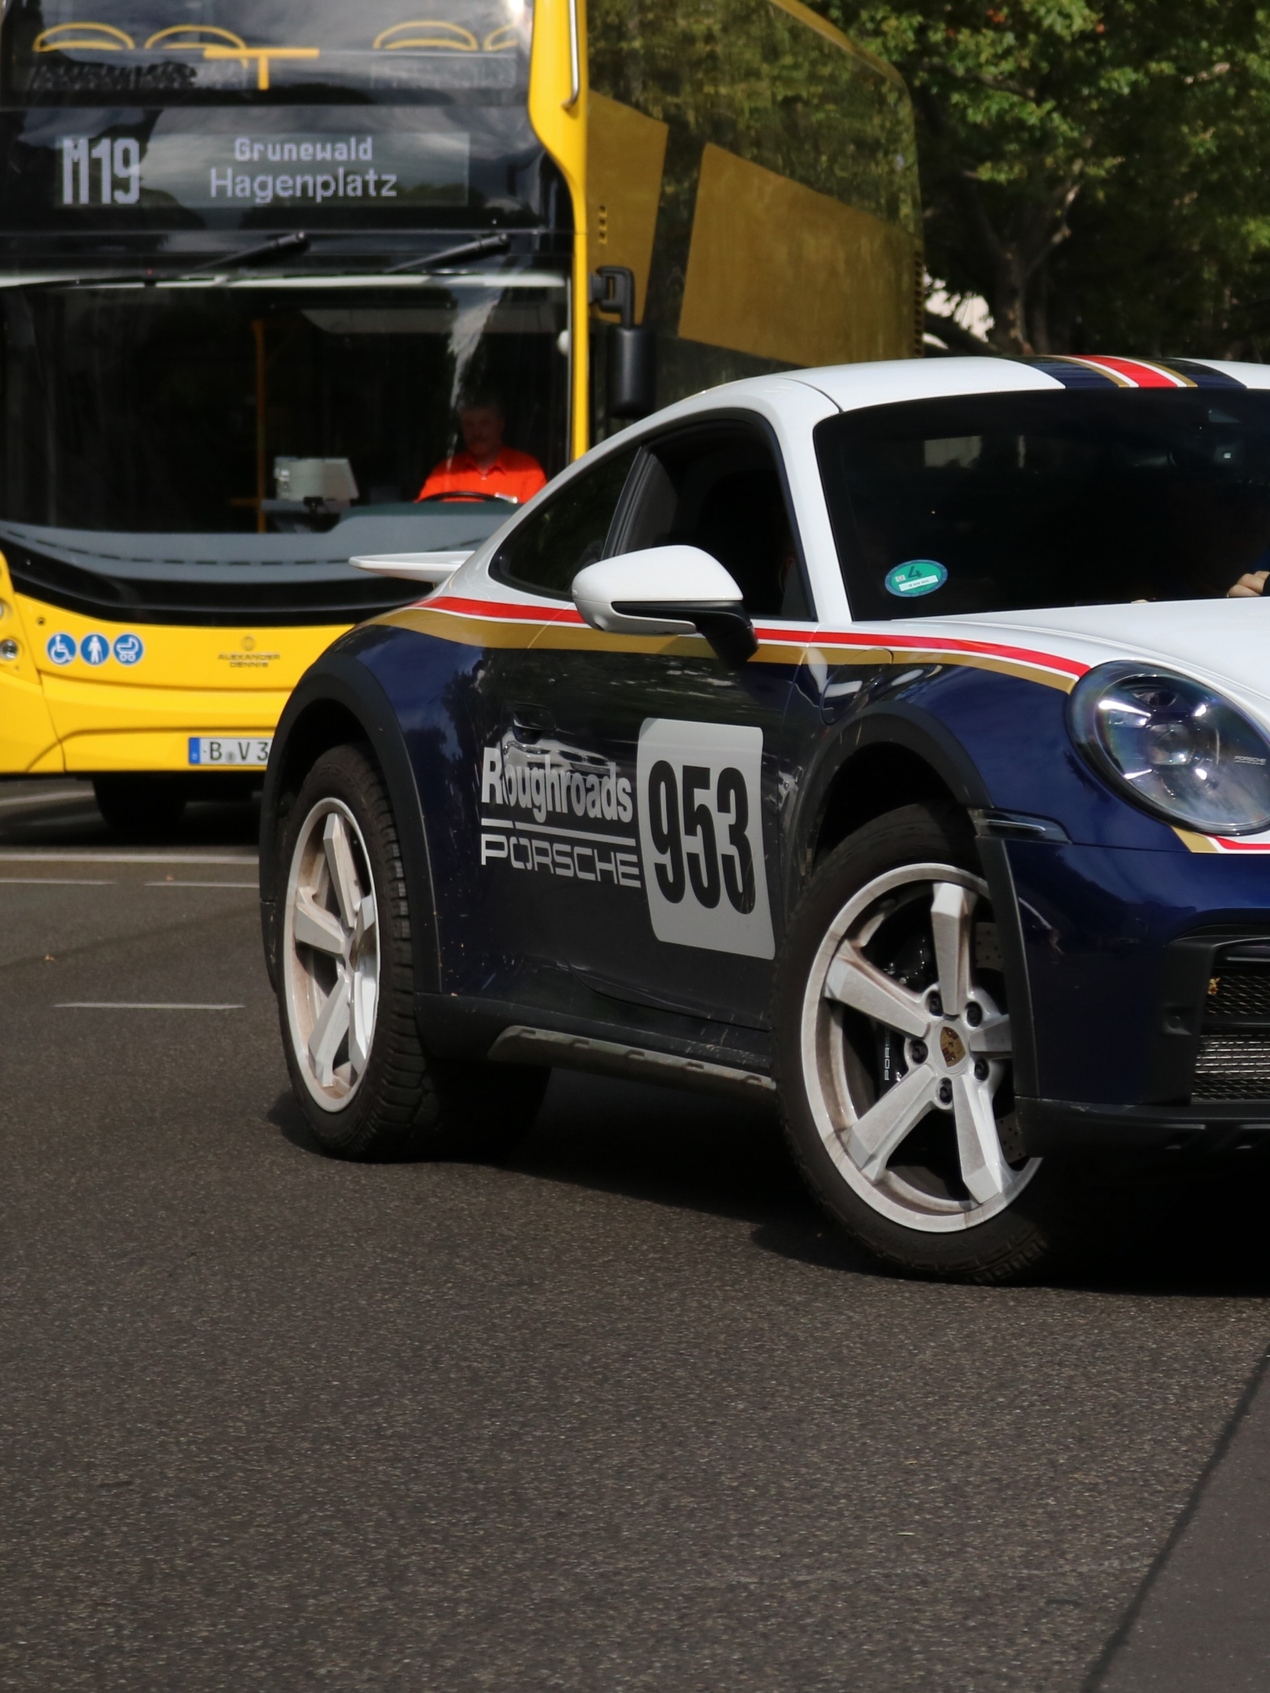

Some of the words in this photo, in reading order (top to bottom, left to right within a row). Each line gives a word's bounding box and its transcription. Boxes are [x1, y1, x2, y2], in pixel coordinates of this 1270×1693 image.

[62, 138, 141, 205] M19
[234, 136, 373, 162] Grunewald
[210, 166, 398, 204] Hagenplatz
[209, 741, 223, 761] B
[237, 741, 251, 761] V
[256, 741, 269, 761] 3
[481, 747, 633, 823] Roughroads
[481, 833, 642, 888] PORSCHE
[648, 759, 756, 915] 953
